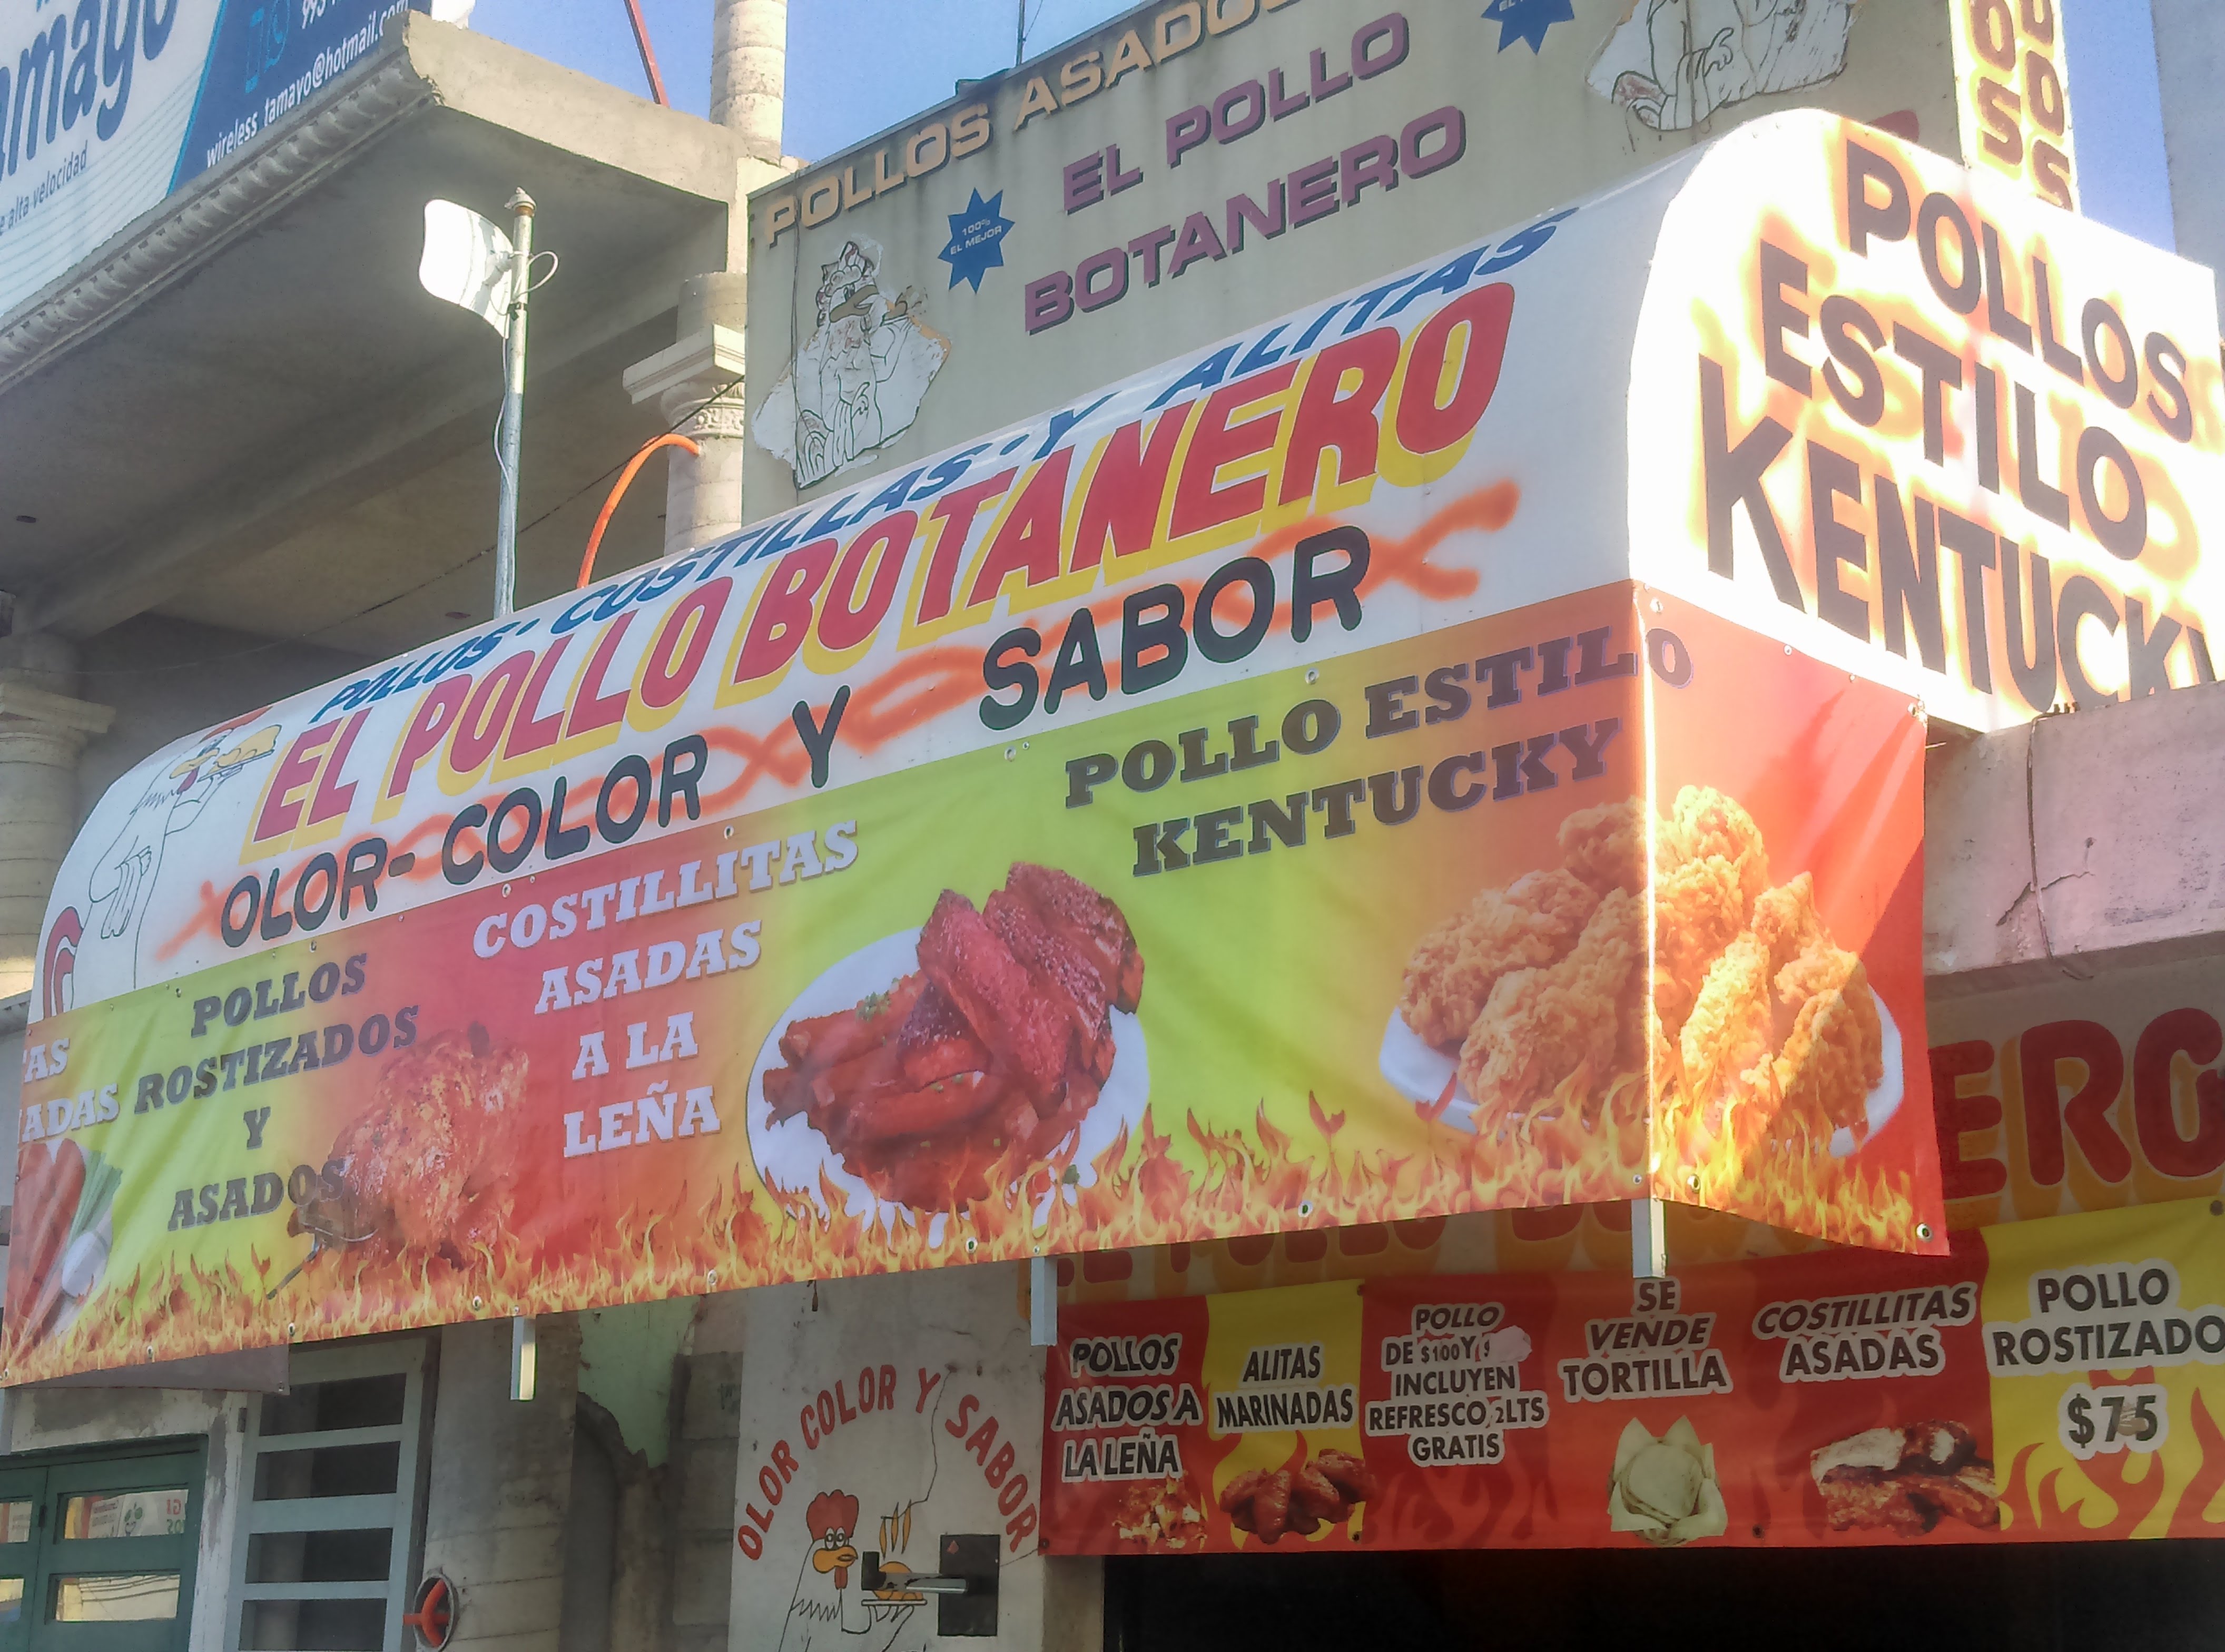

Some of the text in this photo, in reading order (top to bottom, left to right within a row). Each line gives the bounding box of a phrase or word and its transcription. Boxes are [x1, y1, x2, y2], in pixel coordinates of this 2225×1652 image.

[765, 0, 1301, 249] POLLOS ASADO
[1063, 12, 1410, 215] EL POLLO
[33, 140, 88, 209] velocidad
[950, 225, 1002, 255] EL MEJOR
[962, 218, 991, 236] 100%
[1025, 106, 1466, 337] BOTANERO
[1846, 138, 2193, 444] POLLOS
[550, 442, 992, 634] COSTILLAS
[1032, 391, 1123, 461] Y
[1143, 207, 1579, 412] ALITAS
[1759, 239, 2148, 561] ESTILO
[239, 282, 1515, 866] EL POLLO BOTANERO
[441, 734, 708, 884] COLOR
[792, 685, 851, 790] Y
[979, 525, 1371, 731] SABOR
[1065, 625, 1694, 809] POLLO ESTILO
[1133, 717, 1622, 877] KENTUCKY
[473, 820, 858, 959] COSTILLITAS
[534, 920, 762, 1015] ASADAS
[191, 953, 367, 1038] POLLOS
[23, 1038, 70, 1083] AS
[134, 1005, 420, 1115] ROSTIZADOS
[572, 1011, 699, 1081] A LA
[18, 1083, 120, 1142] ADAS
[243, 1106, 271, 1149] Y
[563, 1080, 722, 1158] LEÑA
[168, 1159, 348, 1231] ASADOS
[1637, 1281, 1676, 1312] SE
[1758, 1287, 1972, 1334] COSTILLITAS
[2037, 1268, 2169, 1313] POLLO
[1416, 1306, 1500, 1331] POLLO
[1590, 1316, 1711, 1351] VENDE
[1994, 1315, 2225, 1366] ROSTIZADO
[1073, 1338, 1178, 1372] POLLOS
[1243, 1345, 1321, 1382] ALITAS
[1386, 1341, 1413, 1365] DE
[1563, 1355, 1728, 1397] TORTILLA
[1785, 1333, 1940, 1376] ASADAS
[1396, 1365, 1515, 1397] INCLUYEN
[1056, 1389, 1199, 1425] ASADOS A
[1216, 1388, 1353, 1428] MARINADAS
[1370, 1401, 1486, 1430] REFRESCO
[739, 1364, 1037, 1560] OLOR COLOR Y SABOR
[1065, 1433, 1179, 1477] LA LEÑA
[1412, 1433, 1500, 1461] GRATIS
